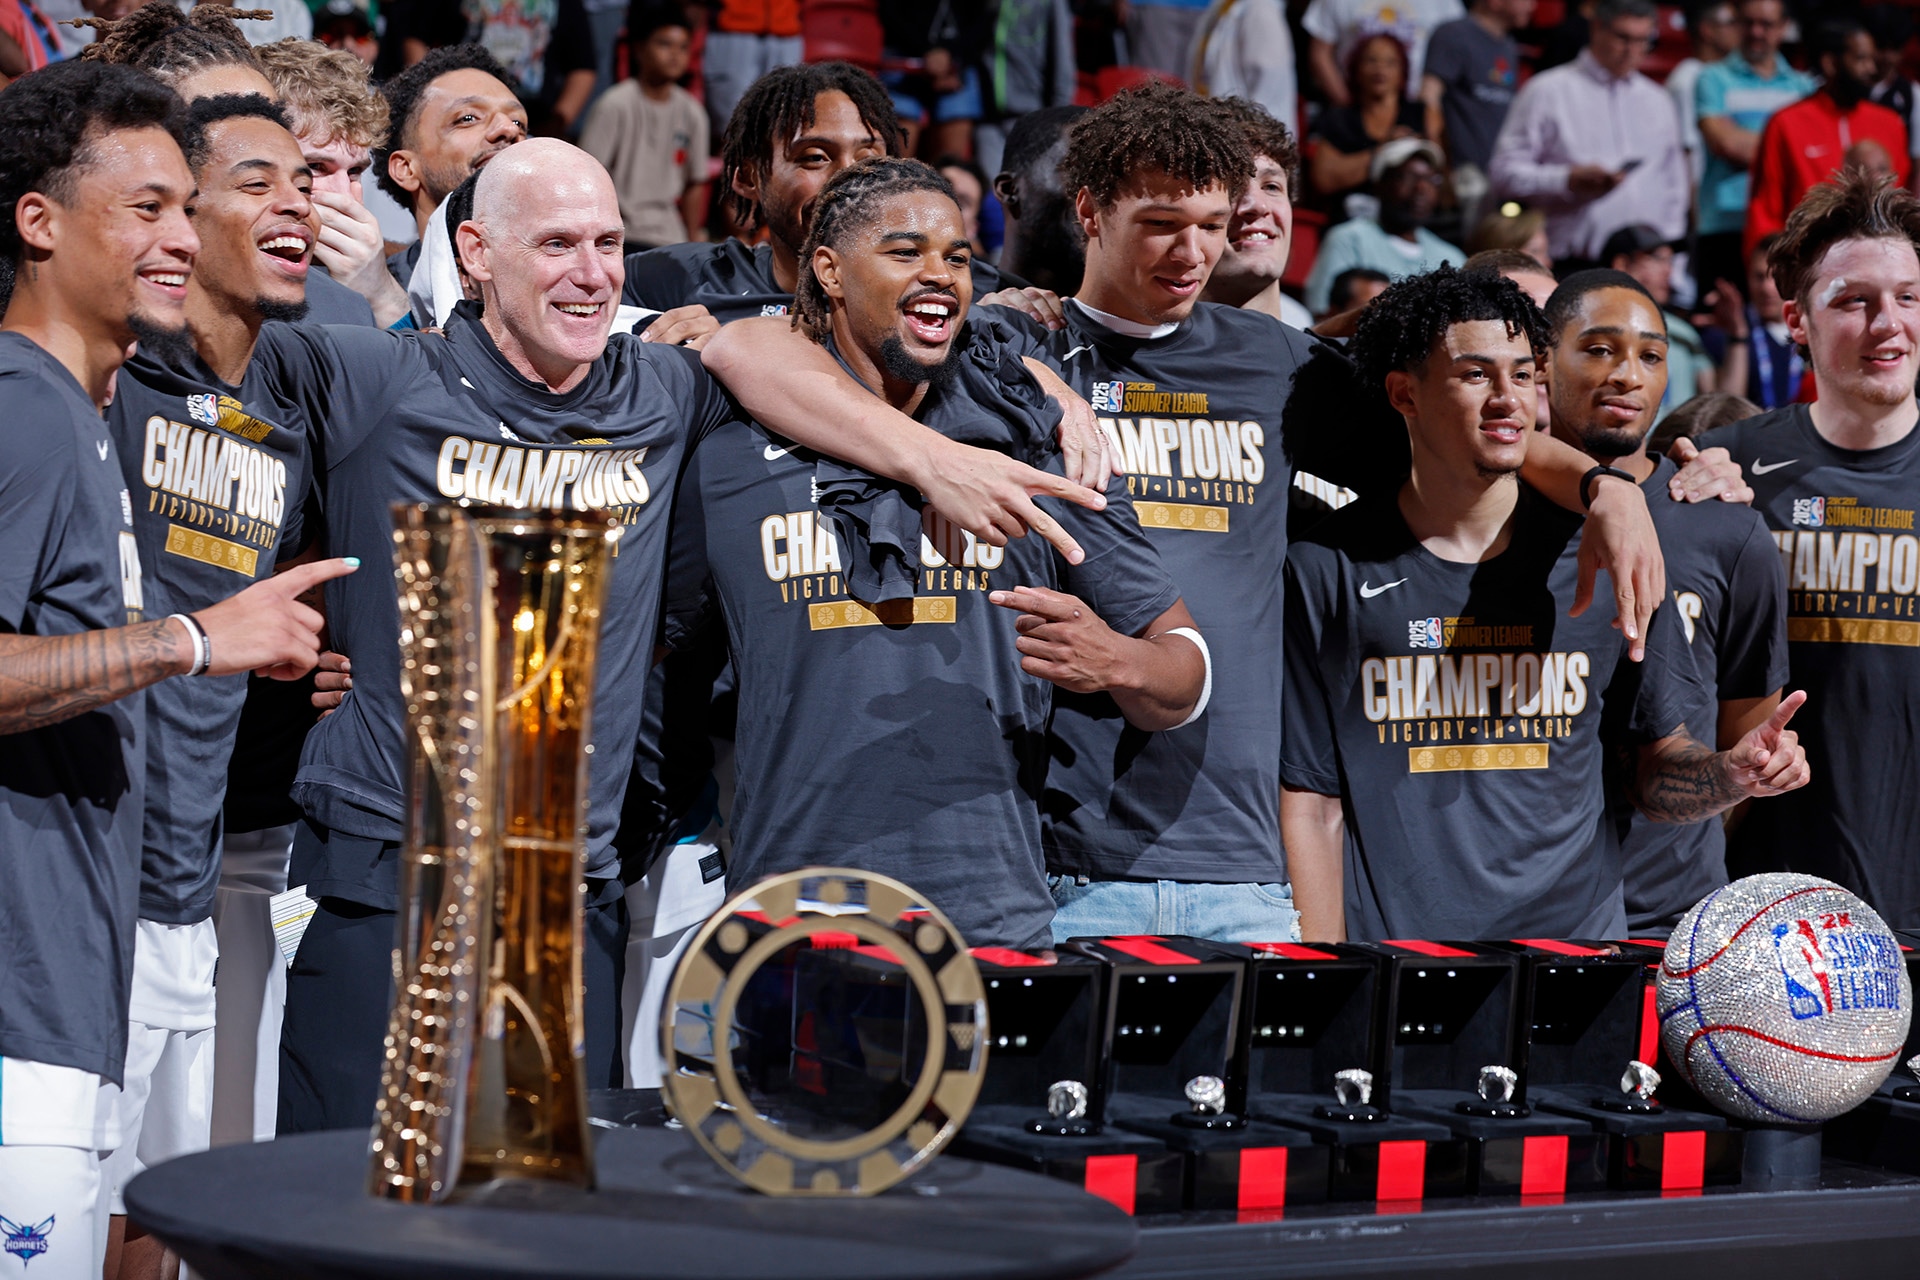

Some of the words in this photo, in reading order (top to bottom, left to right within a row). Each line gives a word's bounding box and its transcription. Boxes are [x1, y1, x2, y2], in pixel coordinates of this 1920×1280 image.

[1091, 382, 1110, 411] 2025
[1123, 391, 1171, 413] SUMMER
[1171, 392, 1209, 414] LEAGUE
[1097, 417, 1265, 485] AMPIONS
[142, 415, 286, 529] CHAMPIONS
[437, 435, 650, 509] CHAMPIONS
[1166, 478, 1187, 499] IN
[1201, 480, 1255, 506] VEGAS
[148, 490, 215, 529] VICTORY
[245, 519, 278, 551] VEGAS
[1792, 499, 1812, 526] 2025
[1825, 505, 1873, 528] SUMMER
[1873, 507, 1915, 531] LEAGUE
[1770, 530, 1920, 595] AMPIO
[780, 575, 848, 603] VICTO
[925, 569, 990, 592] VEGAS
[1408, 619, 1428, 649] 2025
[1443, 626, 1492, 649] SUMMER
[1493, 625, 1535, 647] LEAGUE
[1361, 651, 1591, 723] CHAMPIONS
[1376, 720, 1466, 745] VICTORY
[1483, 718, 1504, 740] IN
[1518, 717, 1573, 739] VEGAS
[1819, 912, 1854, 930] 2K
[6, 1240, 47, 1251] HORNETS
